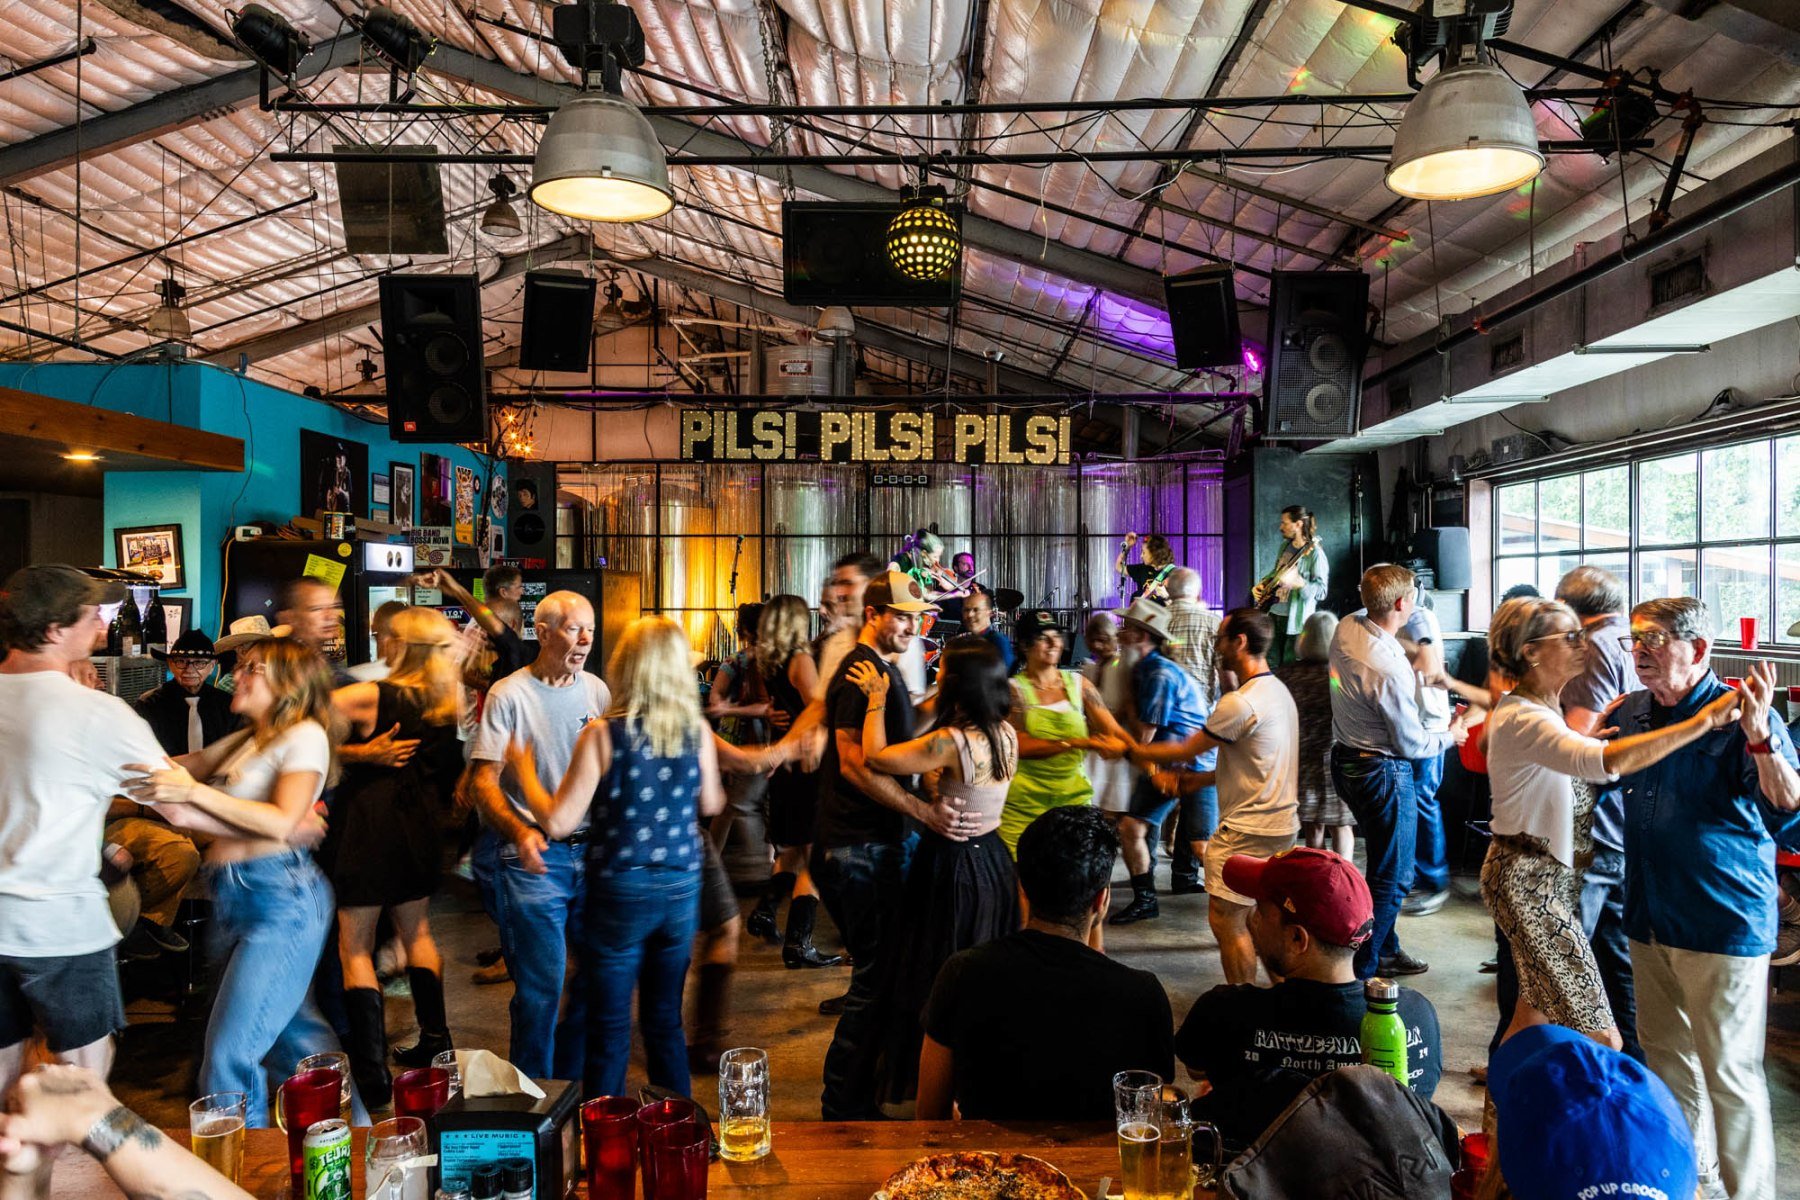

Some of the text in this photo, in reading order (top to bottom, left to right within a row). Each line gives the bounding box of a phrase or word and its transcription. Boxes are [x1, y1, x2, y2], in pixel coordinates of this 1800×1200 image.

[682, 410, 1071, 465] PILS! PILS! PILS!
[423, 529, 440, 537] BAND
[1254, 1029, 1361, 1055] RATTLESNA
[1280, 1056, 1321, 1071] North
[1577, 1185, 1599, 1200] POP
[1600, 1182, 1619, 1195] UP
